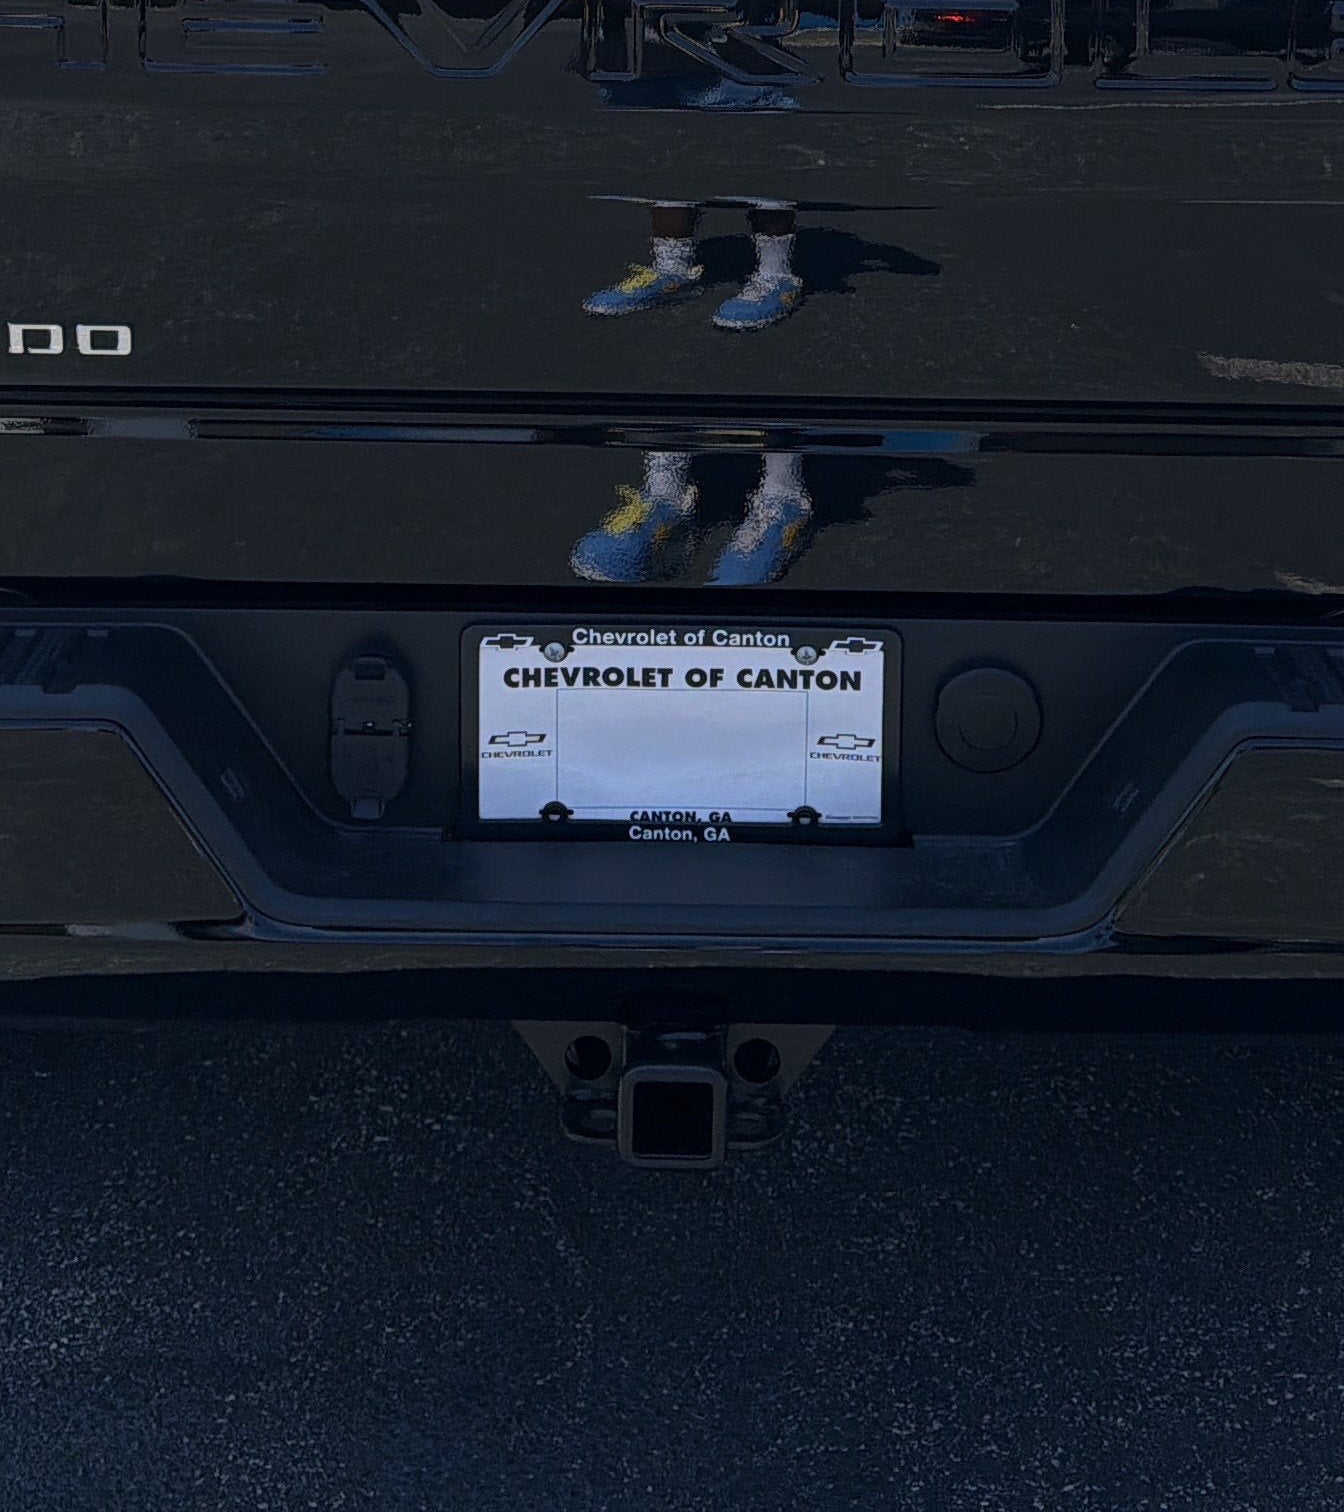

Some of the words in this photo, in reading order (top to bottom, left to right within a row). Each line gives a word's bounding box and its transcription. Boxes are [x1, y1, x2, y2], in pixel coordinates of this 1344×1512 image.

[572, 628, 677, 647] Chevrolet
[684, 628, 706, 647] of
[712, 630, 790, 648] Canton
[503, 667, 674, 689] CHEVROLET
[685, 667, 725, 689] OF
[736, 668, 862, 691] CANTON
[481, 750, 553, 759] CHEVROLET
[809, 752, 880, 762] CHEVROLET
[630, 811, 702, 824] CANTON,
[709, 811, 732, 823] GA
[628, 825, 698, 843] Canton,
[703, 827, 731, 842] GA
